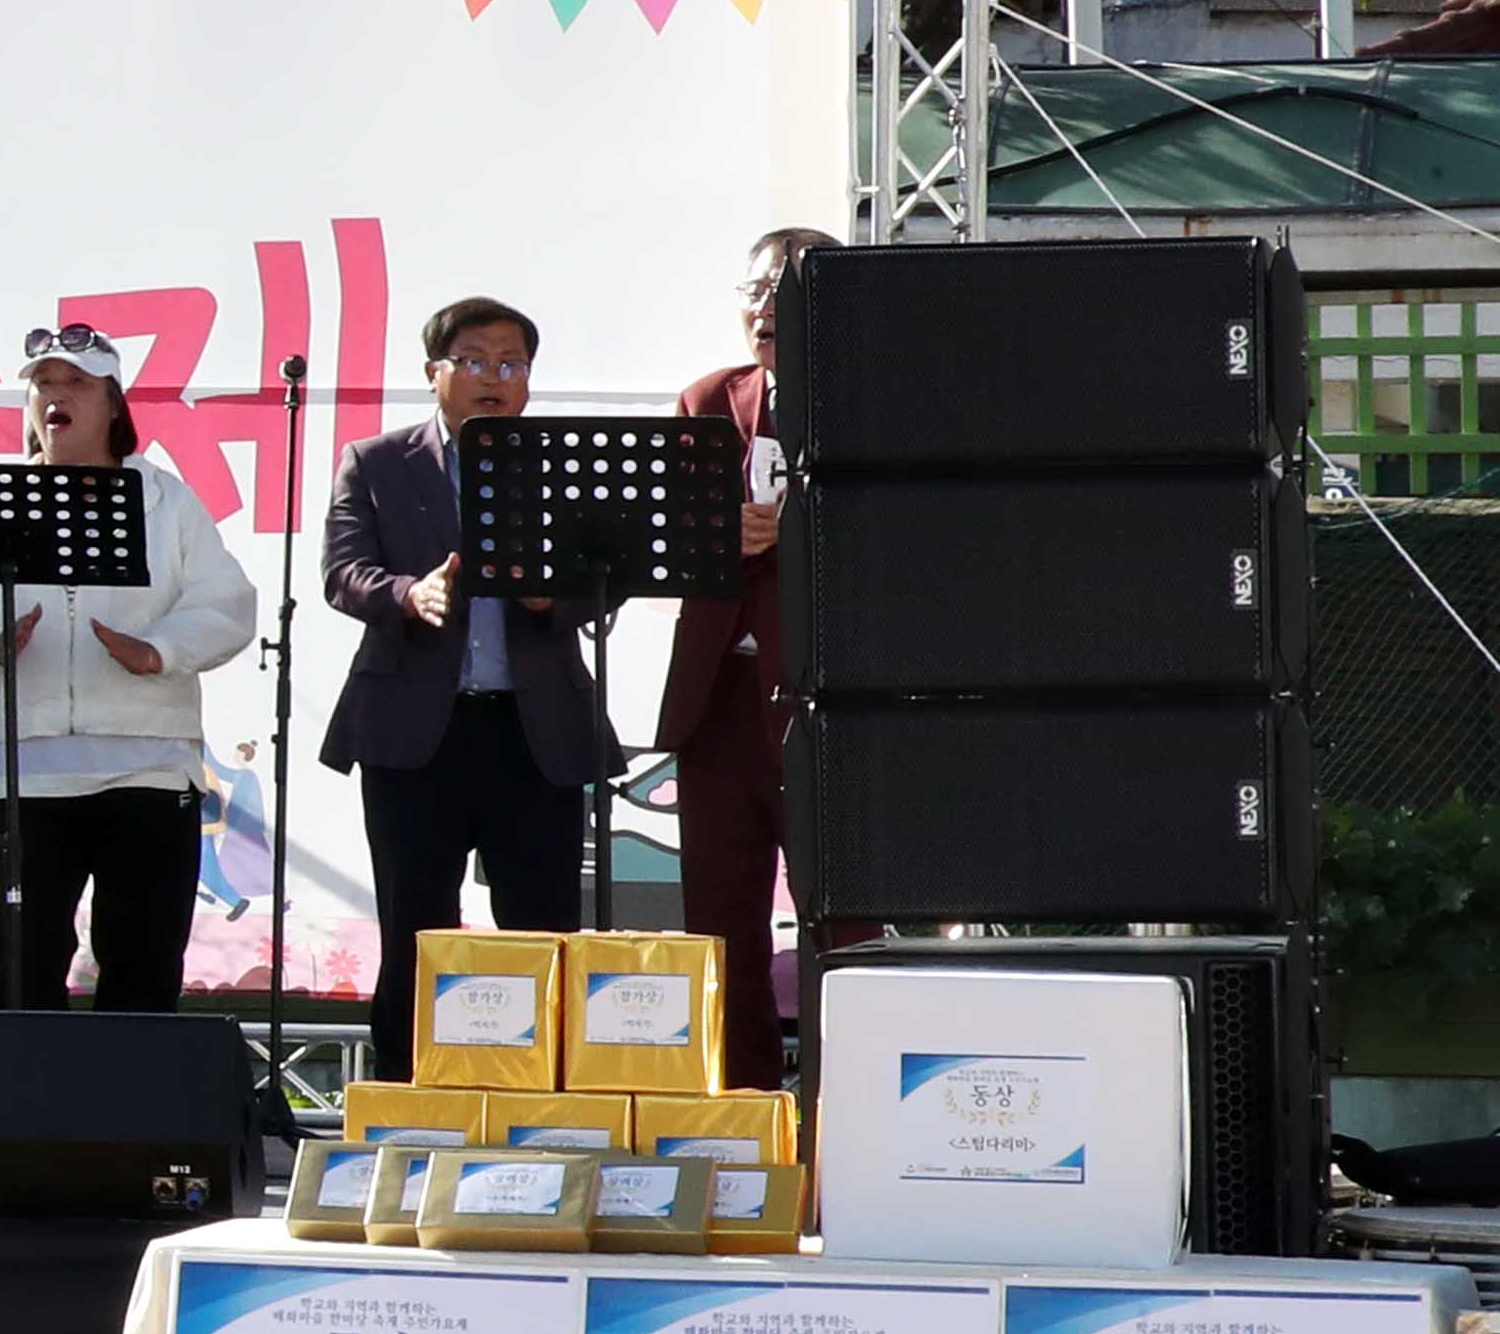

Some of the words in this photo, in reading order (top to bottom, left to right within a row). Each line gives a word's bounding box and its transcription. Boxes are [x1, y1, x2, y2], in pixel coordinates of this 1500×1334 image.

[1229, 324, 1248, 375] NEXO
[1234, 555, 1252, 605] NEXO
[1240, 785, 1258, 836] NEXO
[970, 1084, 1015, 1108] 동상
